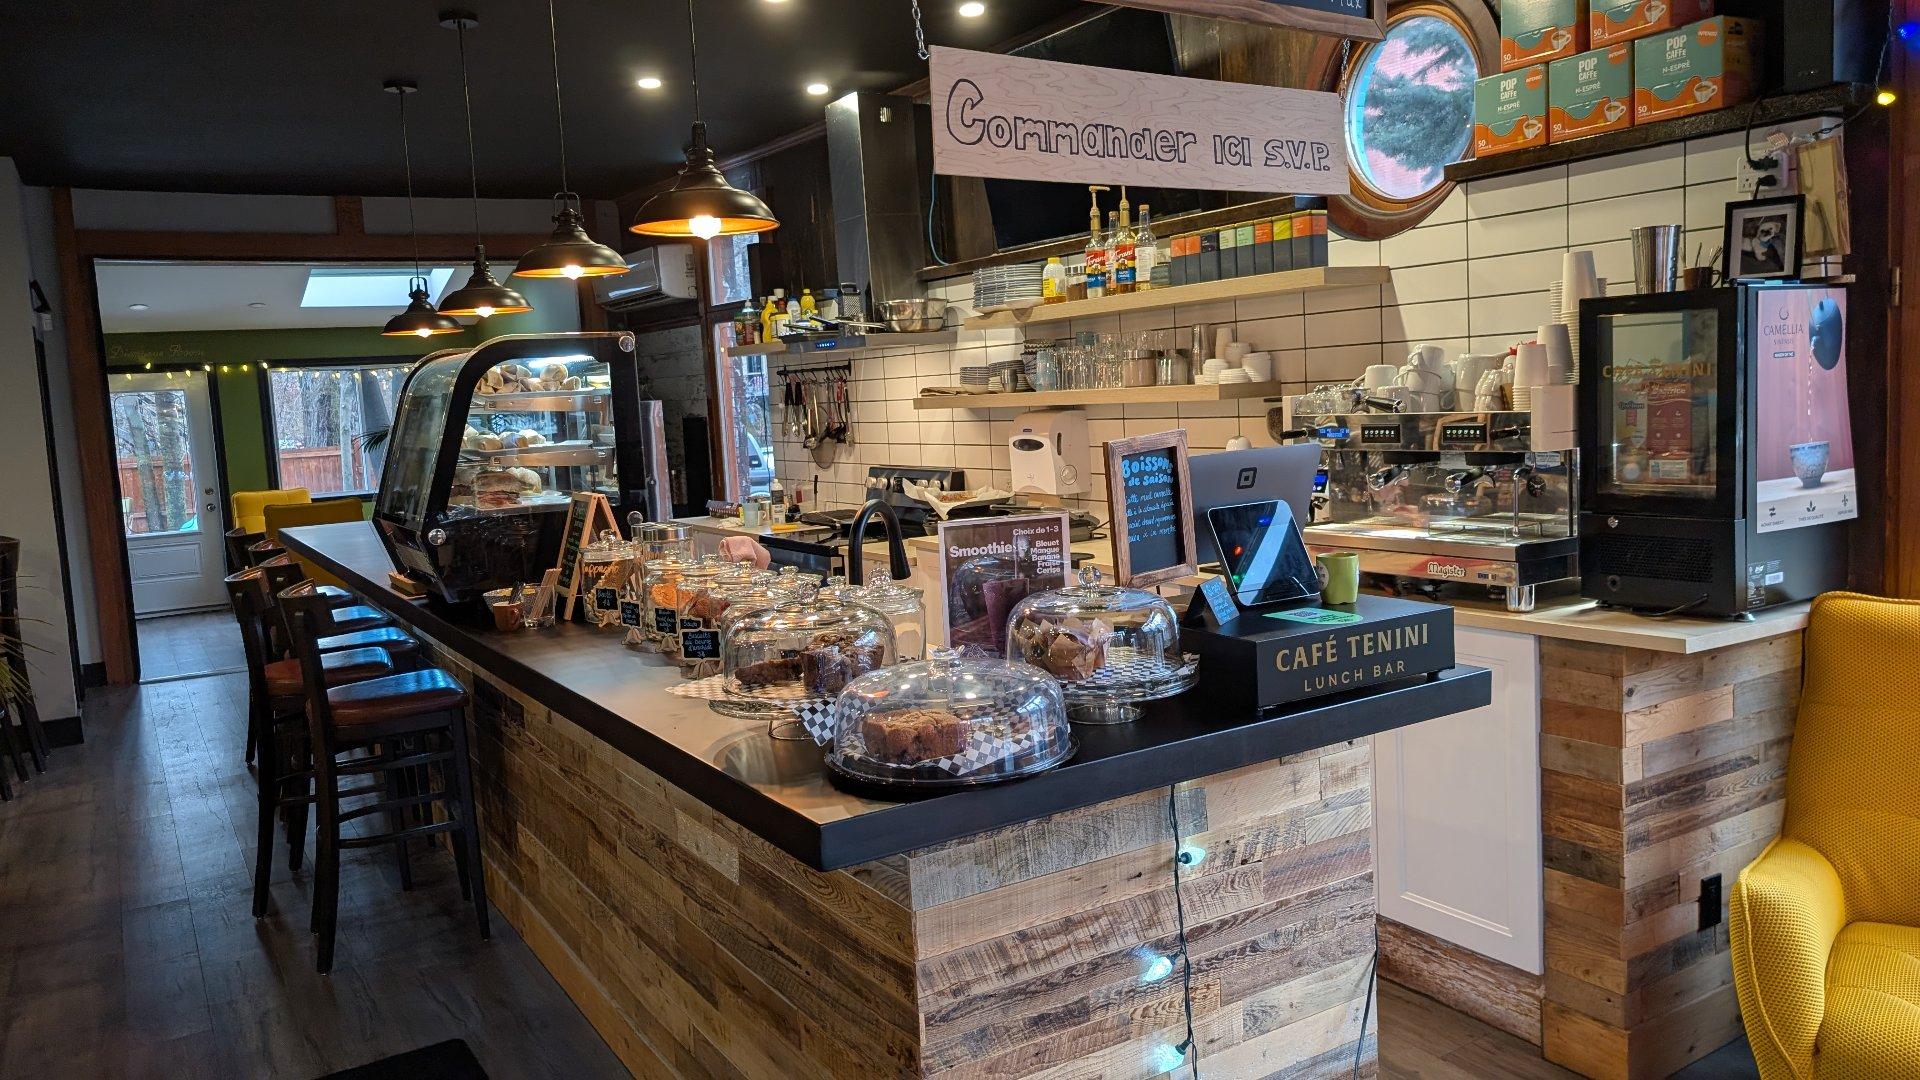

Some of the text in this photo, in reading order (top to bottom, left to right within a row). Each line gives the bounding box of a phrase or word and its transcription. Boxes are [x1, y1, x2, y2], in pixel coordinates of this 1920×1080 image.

[1666, 34, 1687, 51] POP
[1578, 57, 1598, 72] POP
[1500, 78, 1517, 92] POP
[946, 78, 1331, 172] Commander ICI S.V.P.
[1763, 323, 1804, 336] CAMELLIA
[1129, 472, 1174, 487] de saison
[1013, 525, 1059, 536] Choix de 1-3
[1030, 547, 1060, 555] Mangue
[1428, 561, 1467, 579] Magister
[1276, 623, 1428, 672] CAFÉ TENINI
[1304, 660, 1406, 692] LUNCH BAR
